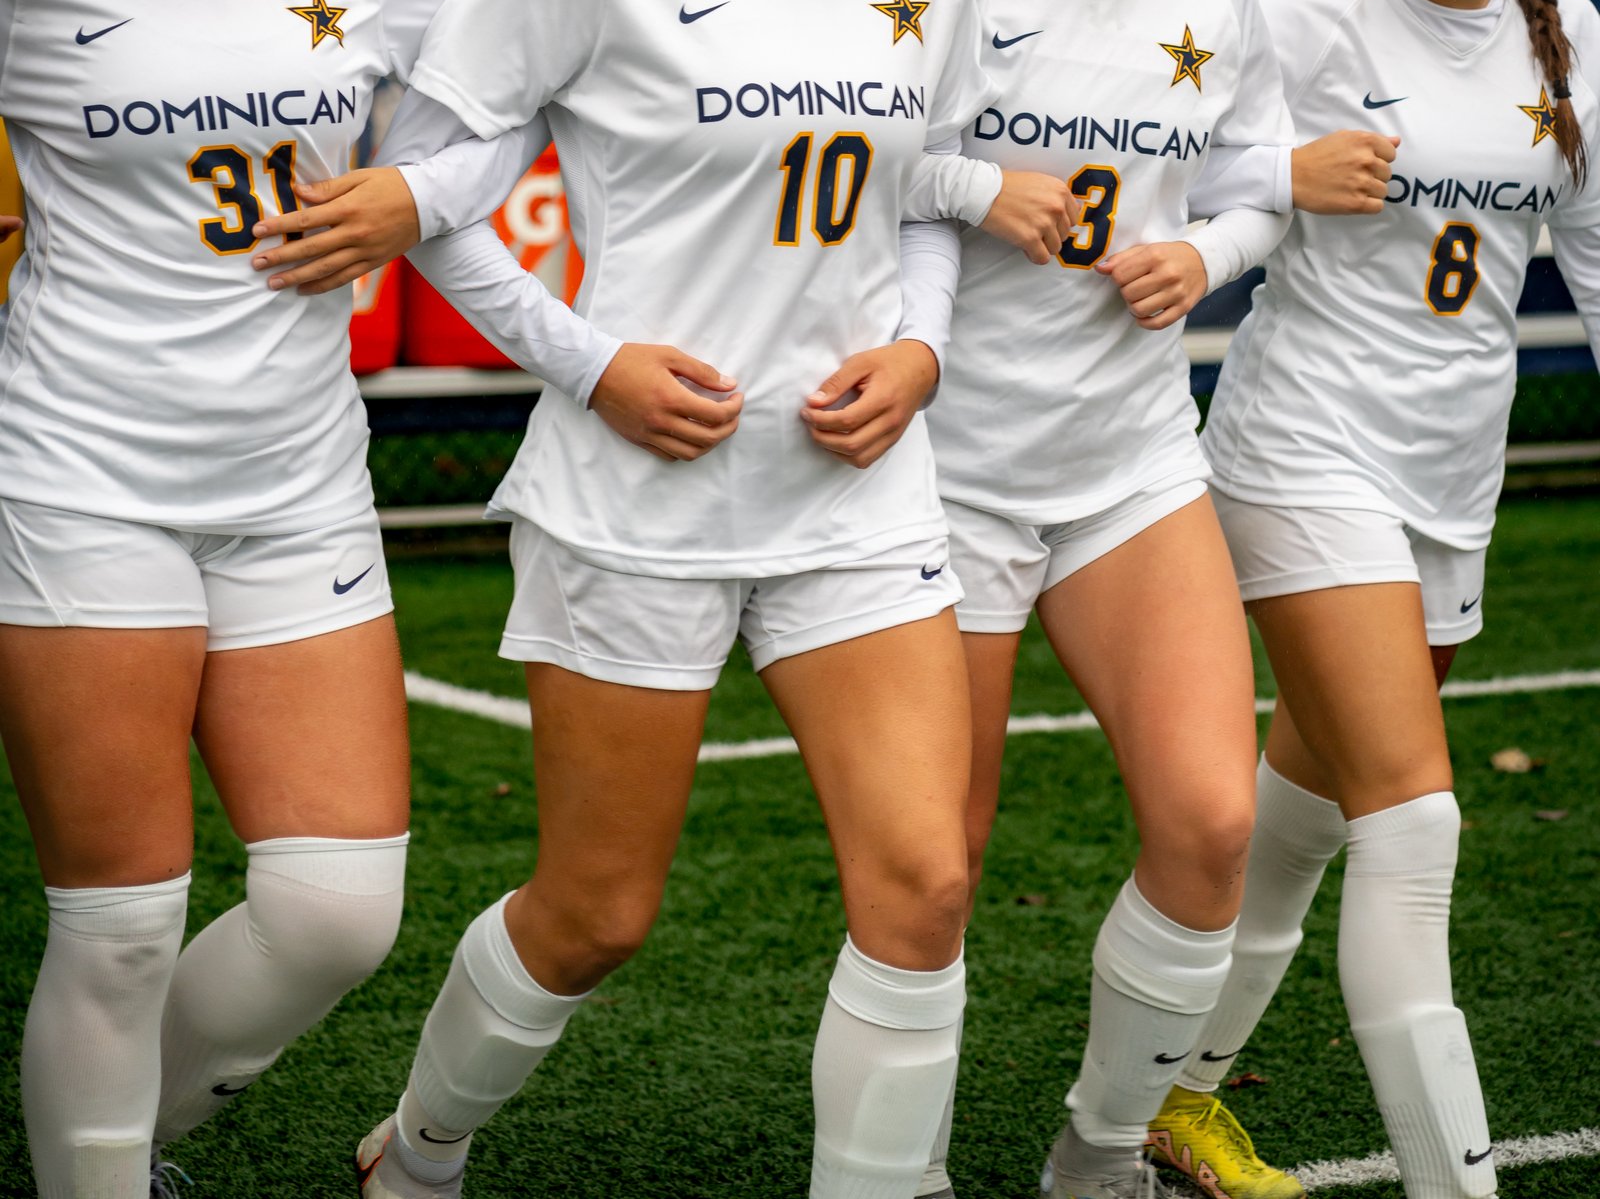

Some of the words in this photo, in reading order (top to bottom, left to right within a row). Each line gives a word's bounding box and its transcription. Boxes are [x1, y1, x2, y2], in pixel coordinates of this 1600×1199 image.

[83, 86, 356, 138] DOMINICAN
[695, 81, 924, 123] DOMINICAN
[974, 107, 1208, 161] DOMINICAN
[186, 140, 304, 257] 31
[773, 131, 874, 247] 10
[1056, 163, 1122, 270] 3
[1384, 174, 1563, 214] OMINICAN
[1424, 221, 1482, 317] 8
